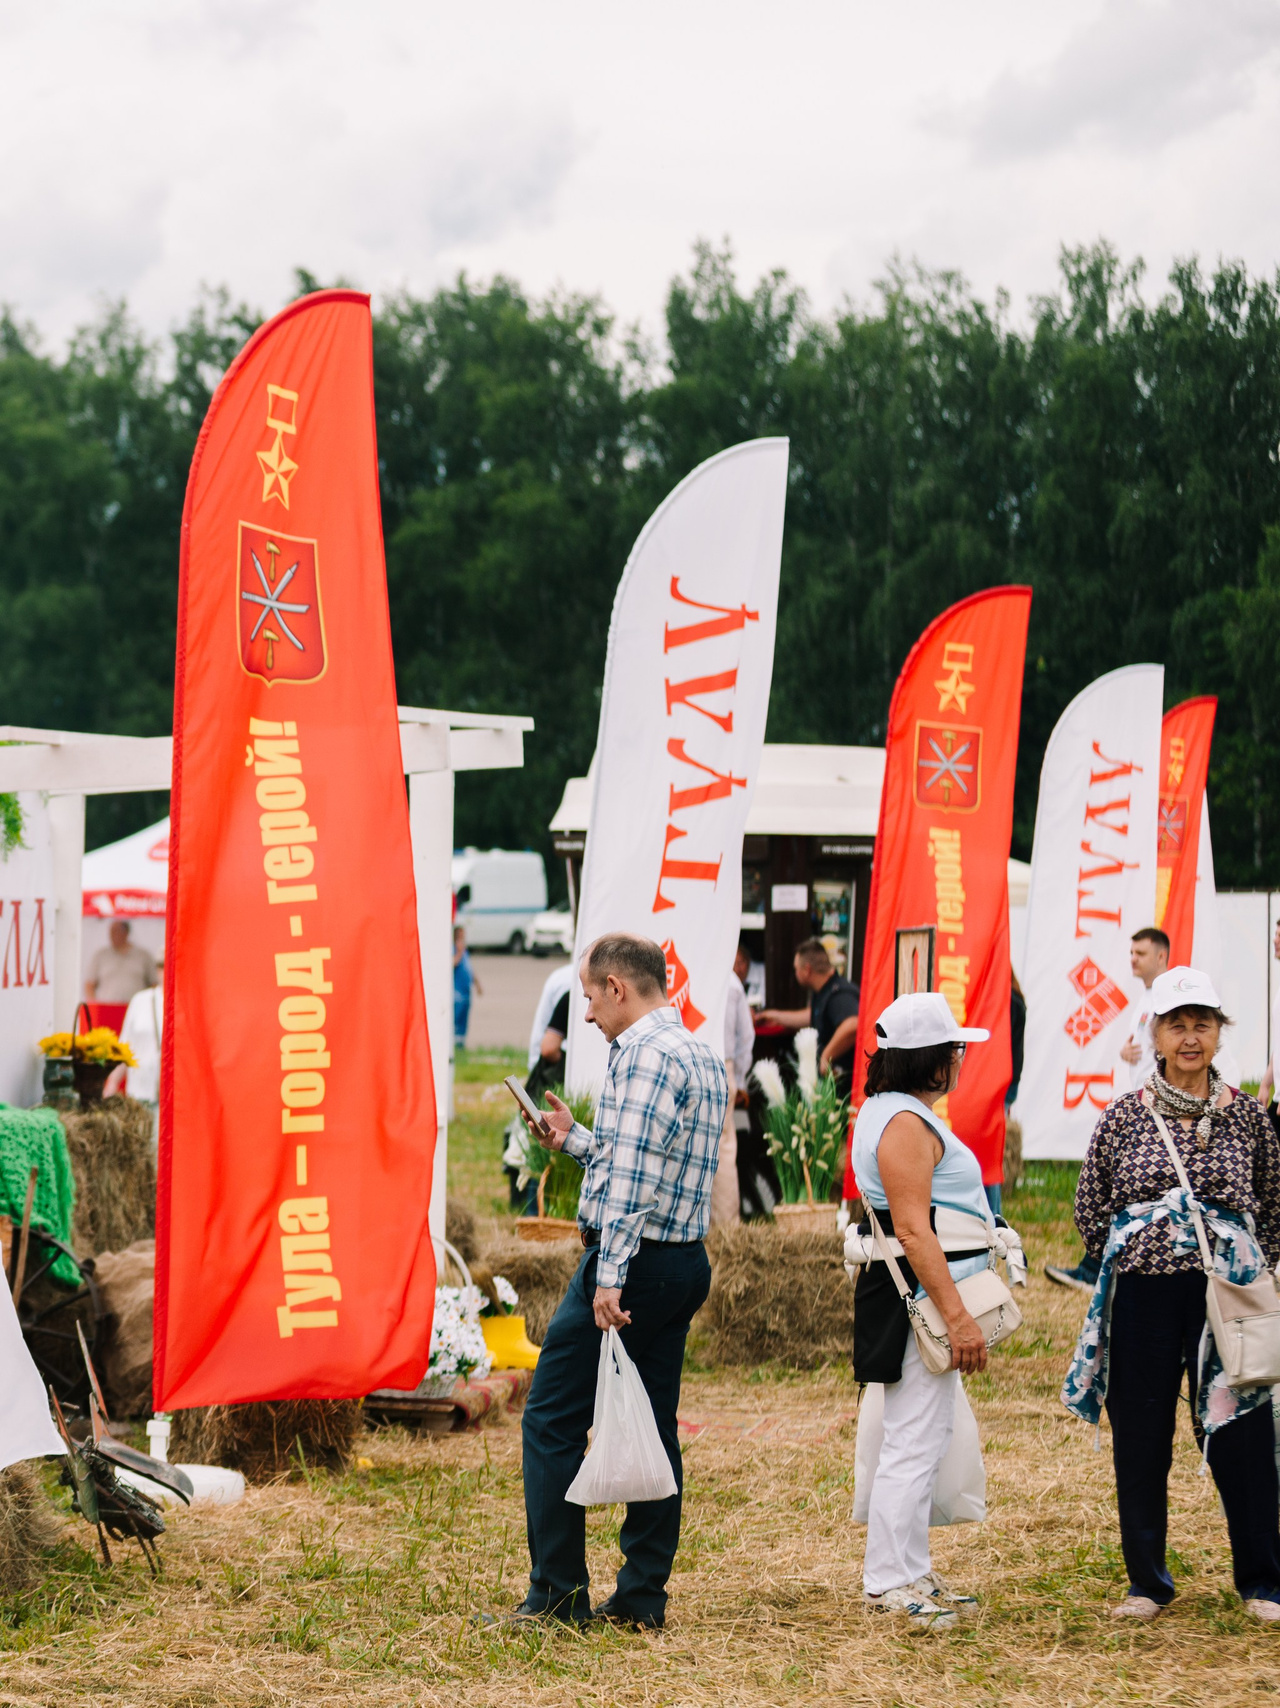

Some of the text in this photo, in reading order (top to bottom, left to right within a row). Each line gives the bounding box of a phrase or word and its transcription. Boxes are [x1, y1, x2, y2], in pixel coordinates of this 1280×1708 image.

[245, 717, 318, 905] герой!
[651, 575, 760, 914] ТУЛУ
[927, 826, 967, 935] герой!
[1074, 739, 1144, 940] ТУЛУ
[274, 947, 333, 1134] город
[276, 1196, 342, 1338] Тула
